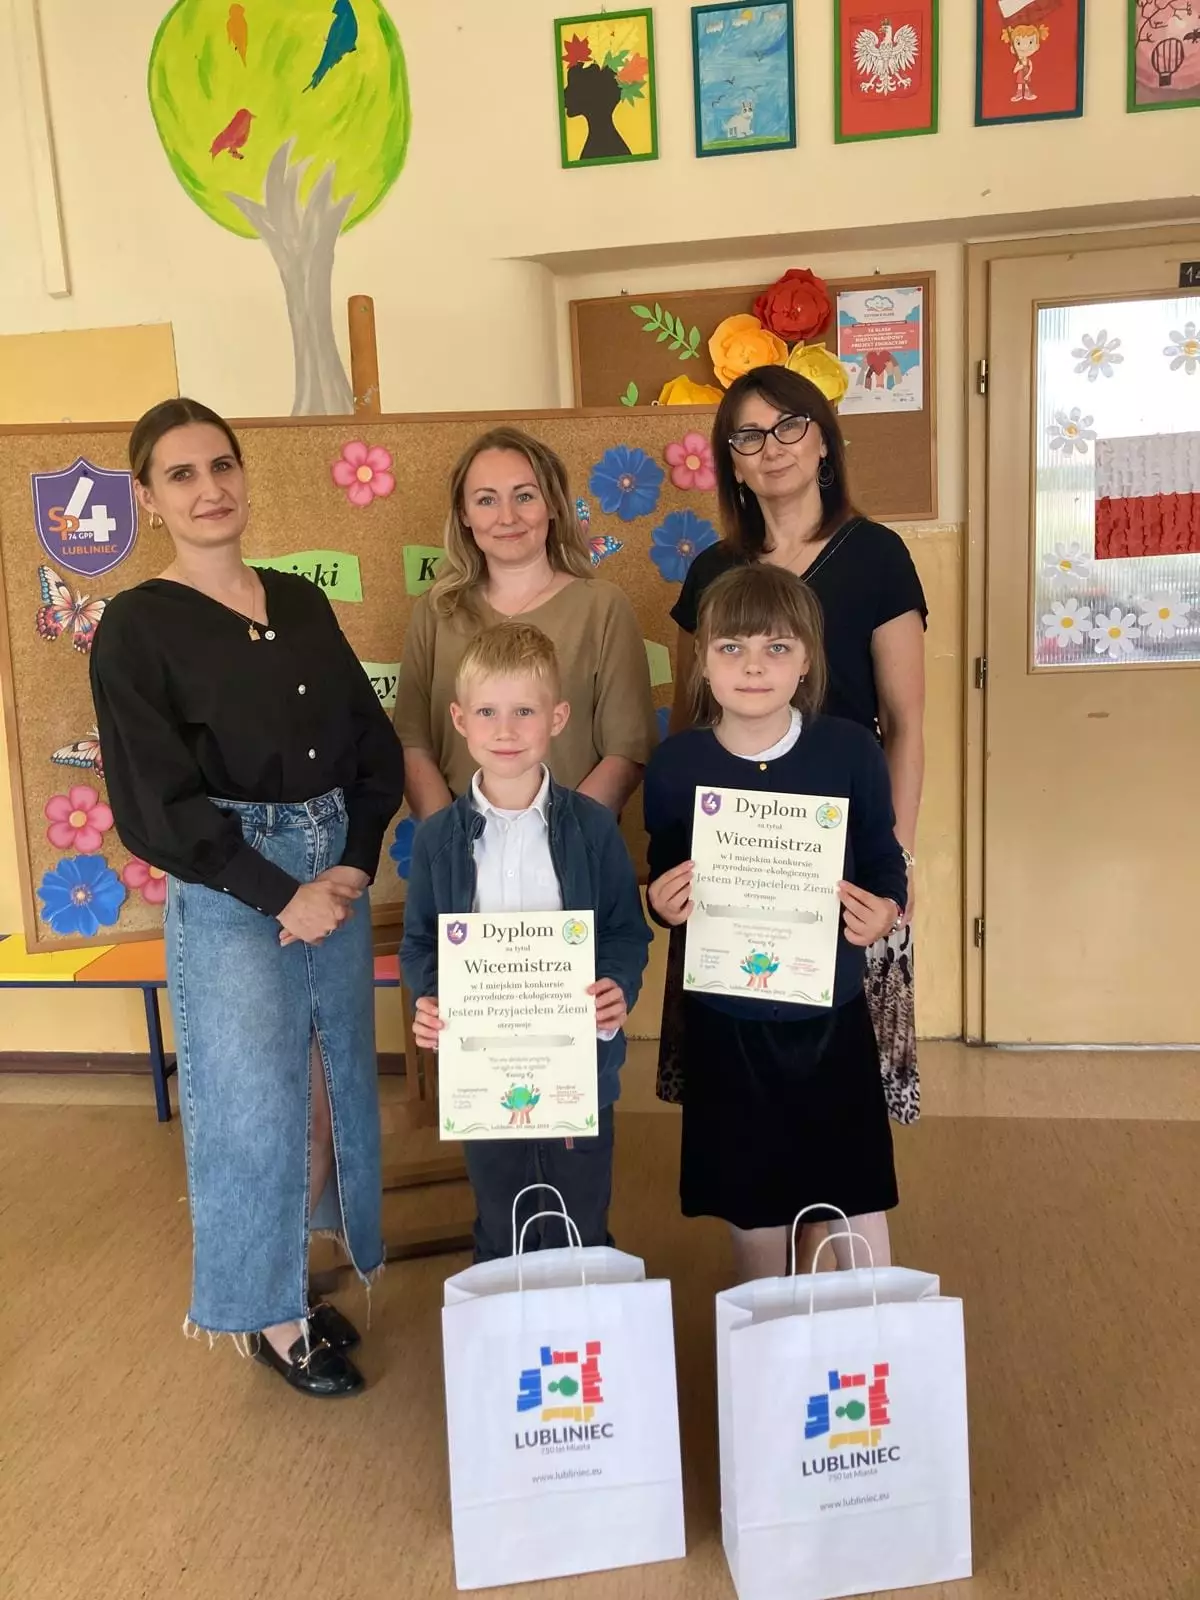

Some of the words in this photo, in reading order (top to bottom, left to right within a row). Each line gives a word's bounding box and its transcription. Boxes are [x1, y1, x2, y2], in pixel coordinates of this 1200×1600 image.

[62, 544, 118, 555] LUBLINIEC
[736, 797, 807, 819] Dyplom
[716, 830, 822, 853] Wicemistrza
[735, 854, 771, 865] miejskim
[773, 857, 813, 868] konkursie
[696, 873, 731, 885] Jestem
[734, 877, 800, 891] Przyjacielem
[803, 884, 834, 895] Ziemi
[482, 921, 554, 943] Dyplom
[464, 958, 572, 974] Wicemistrza
[486, 982, 522, 991] miejskim
[524, 981, 564, 989] konkursie
[448, 1006, 483, 1018] Jestem
[487, 1005, 554, 1018] Przyjacielem
[557, 1004, 588, 1014] Ziemi
[515, 1423, 614, 1450] LUBLINIEC
[802, 1446, 901, 1477] LUBLINIEC
[532, 1468, 602, 1484] www.lubliniec.eu
[854, 1468, 878, 1478] Miasta
[819, 1493, 890, 1511] www.lubliniec.eu
